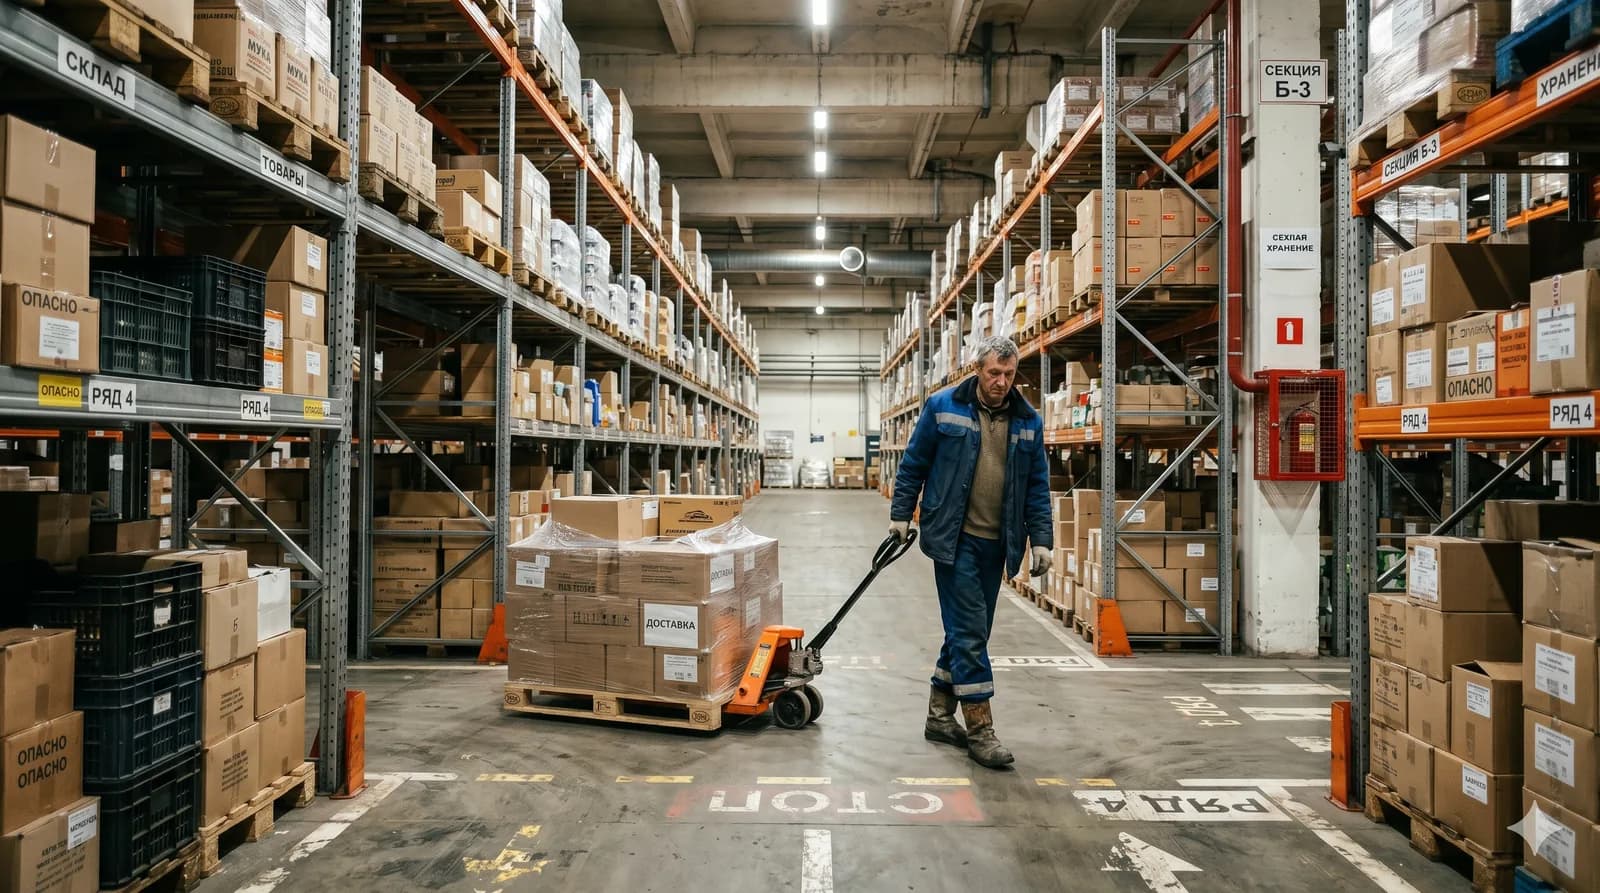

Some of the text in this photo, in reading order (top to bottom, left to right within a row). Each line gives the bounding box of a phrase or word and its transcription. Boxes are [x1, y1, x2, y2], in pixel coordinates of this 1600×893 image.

[248, 39, 271, 65] МУКА
[66, 51, 126, 101] СКЛАД
[287, 63, 308, 86] МУКА
[1265, 65, 1321, 78] СЕКЦИЯ
[1275, 81, 1311, 98] Б-3
[1384, 139, 1437, 177] СЕКЦИЯ Б-3
[262, 155, 304, 188] ТОВАРЫ
[1266, 244, 1314, 252] ХРАНЕНИЕ
[22, 290, 78, 314] ОПАСНО
[41, 384, 80, 399] ОПАСНО
[1448, 376, 1493, 397] ОПАСНО
[92, 388, 134, 408] РЯД 4
[242, 400, 269, 417] РЯД 4
[1552, 404, 1592, 424] РЯД 4
[1403, 414, 1427, 428] РЯД 4
[646, 619, 696, 630] ДОСТАВКА
[17, 735, 67, 767] ОПАСНО
[17, 758, 67, 789] ОПАСНО
[708, 790, 944, 814] СТОП
[1139, 794, 1270, 813] РЯД
